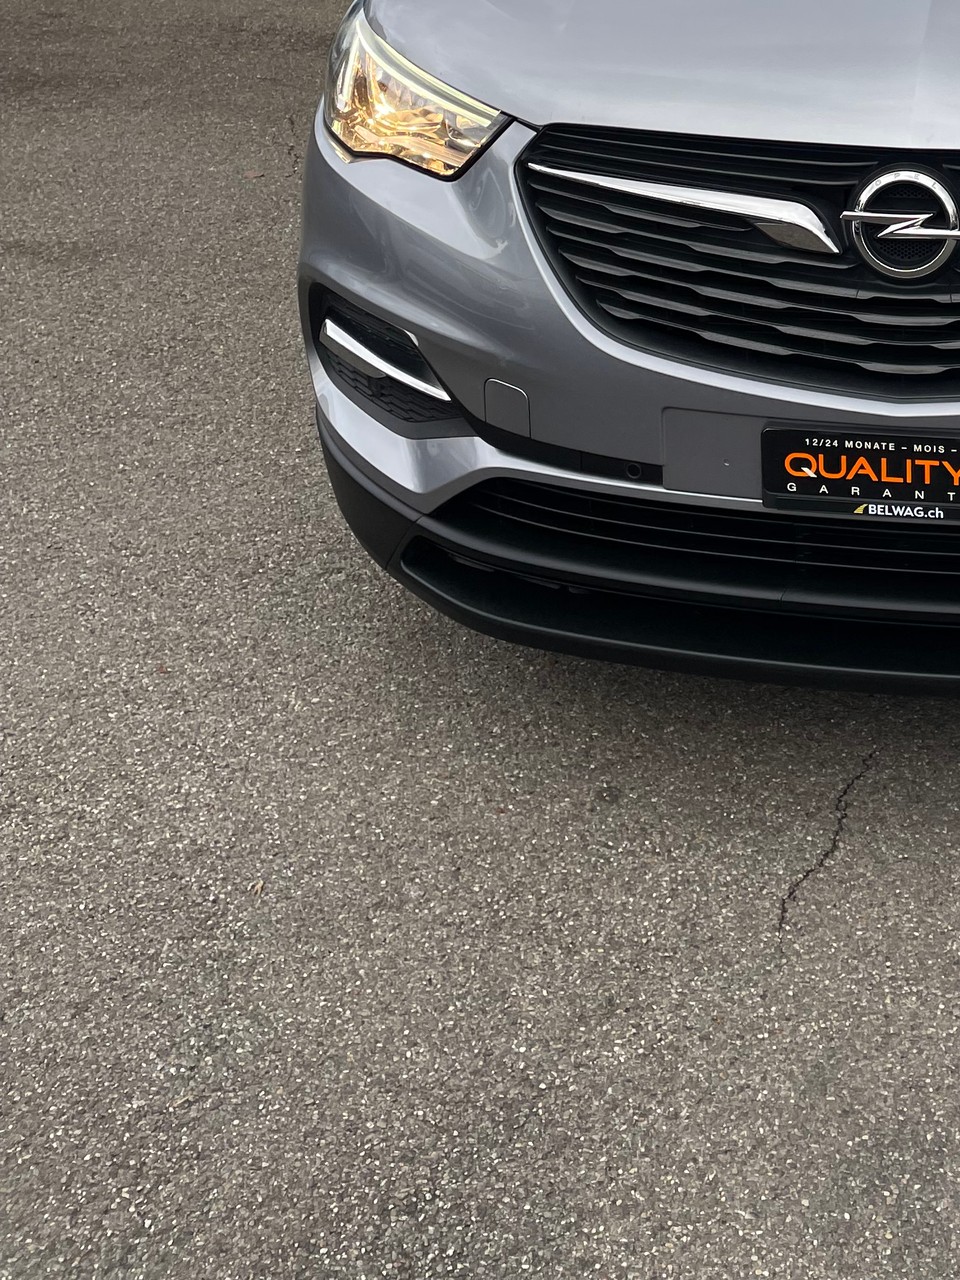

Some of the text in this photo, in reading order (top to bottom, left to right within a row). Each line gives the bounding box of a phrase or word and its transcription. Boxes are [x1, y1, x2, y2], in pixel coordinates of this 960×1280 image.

[874, 172, 938, 191] OPEL
[804, 438, 839, 448] 12/24
[845, 440, 896, 451] MONATE
[913, 444, 945, 454] MOIS
[868, 504, 944, 519] BELWAG.ch
